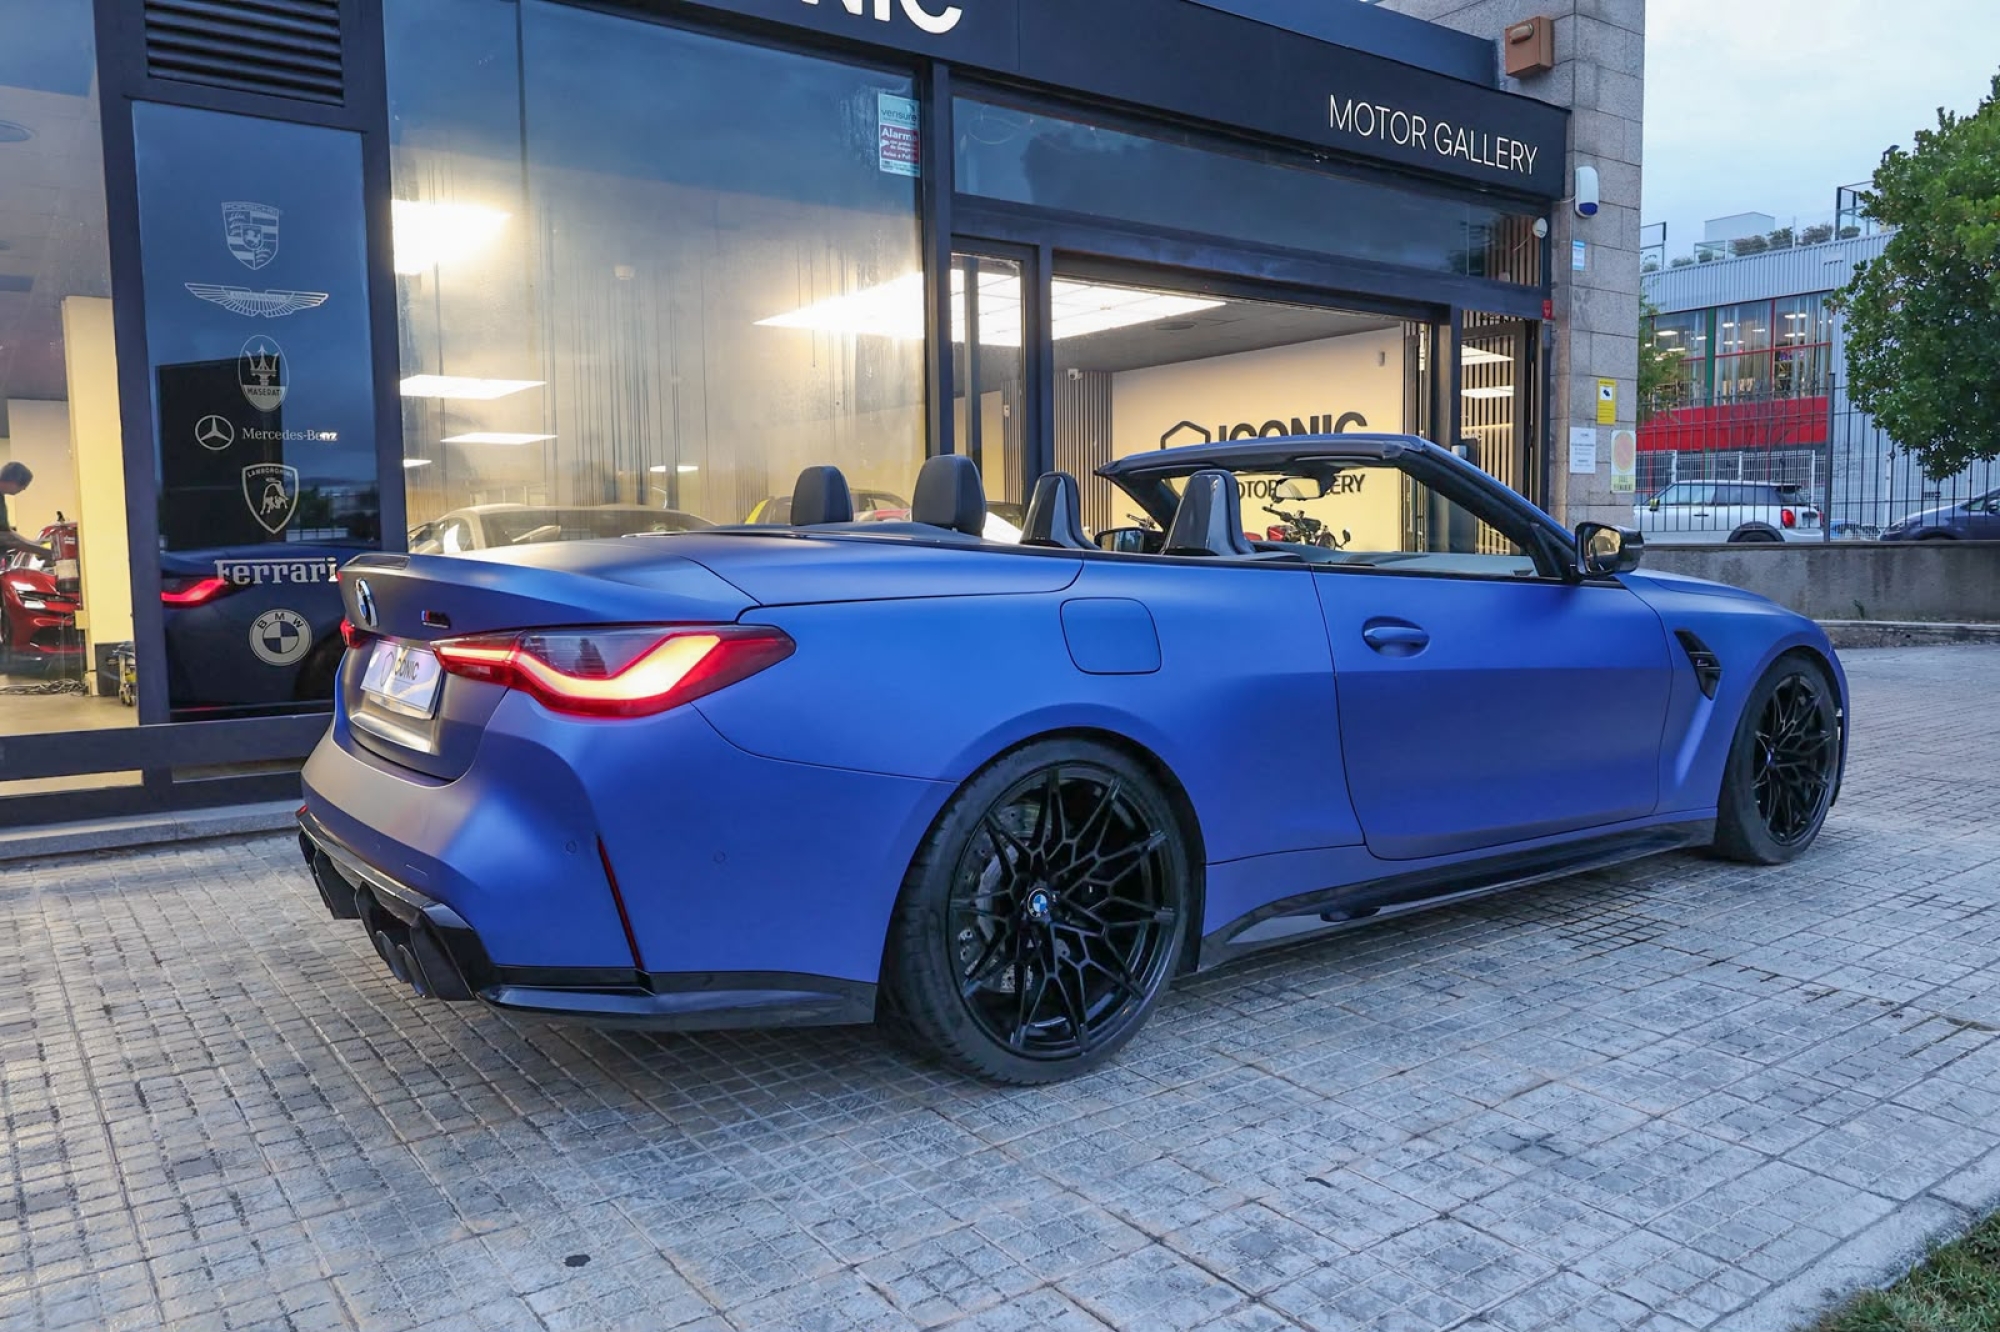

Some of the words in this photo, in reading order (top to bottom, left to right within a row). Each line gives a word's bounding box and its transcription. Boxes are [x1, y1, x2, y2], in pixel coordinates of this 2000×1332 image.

[1329, 94, 1427, 150] MOTOR
[1434, 121, 1538, 175] GALLERY
[242, 427, 338, 442] Mercedes-Benz
[214, 557, 339, 585] Ferrari
[257, 612, 303, 629] BMW
